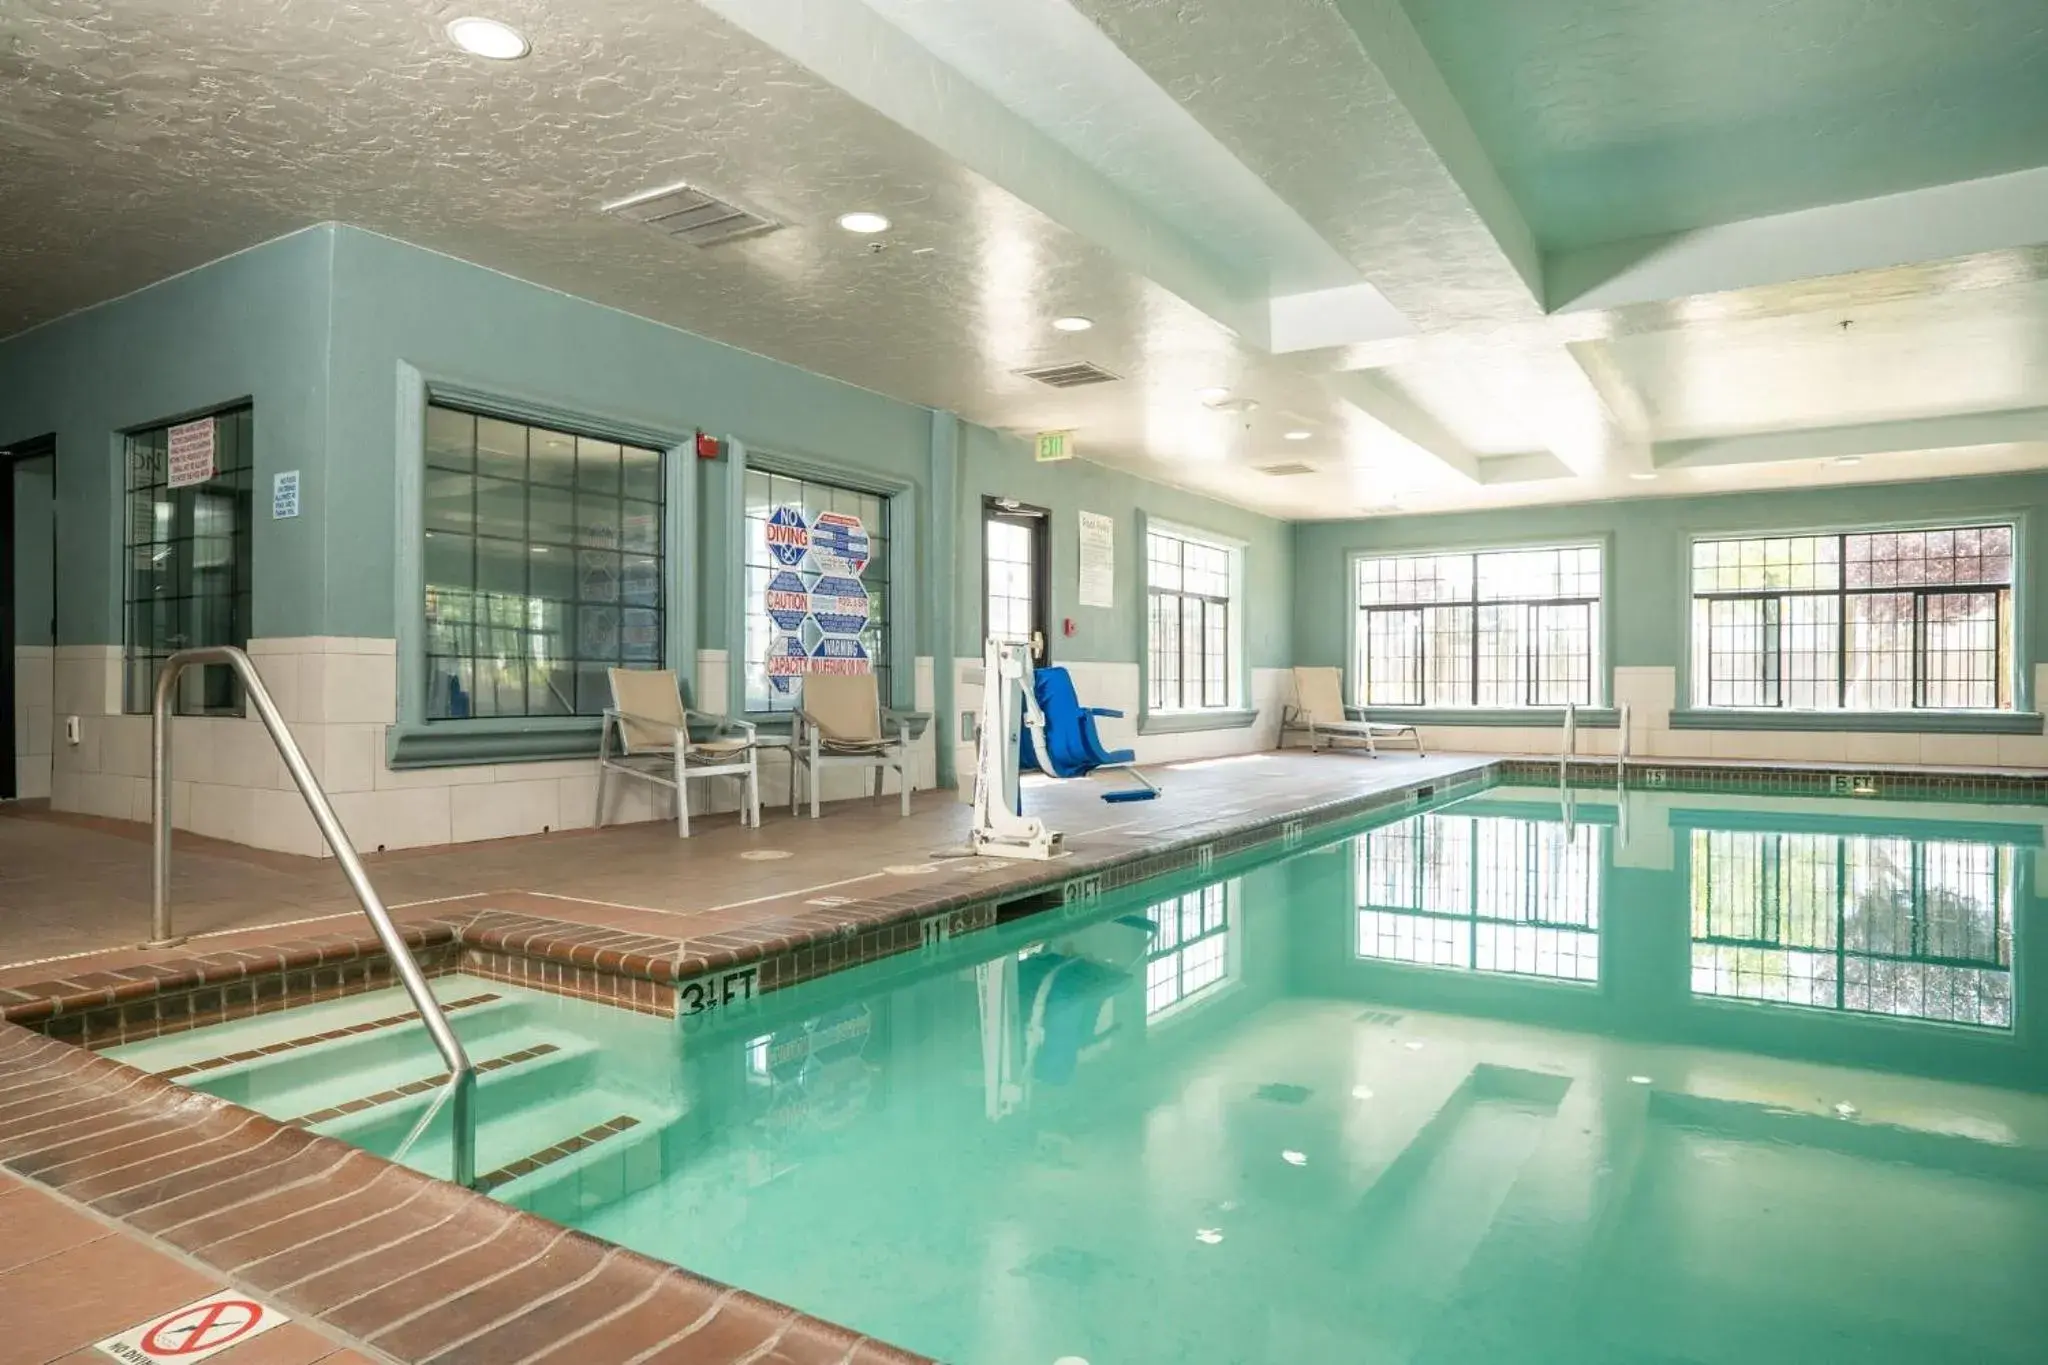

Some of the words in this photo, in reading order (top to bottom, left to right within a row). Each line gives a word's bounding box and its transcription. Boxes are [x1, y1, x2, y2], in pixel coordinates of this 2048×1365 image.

[1041, 435, 1063, 458] EXIT
[780, 507, 798, 527] NO
[766, 524, 808, 546] DIVING
[767, 591, 807, 610] CAUTION
[824, 639, 858, 656] WARNING
[768, 656, 806, 674] CAPACITY
[722, 968, 757, 1005] FT
[108, 1341, 131, 1354] NO
